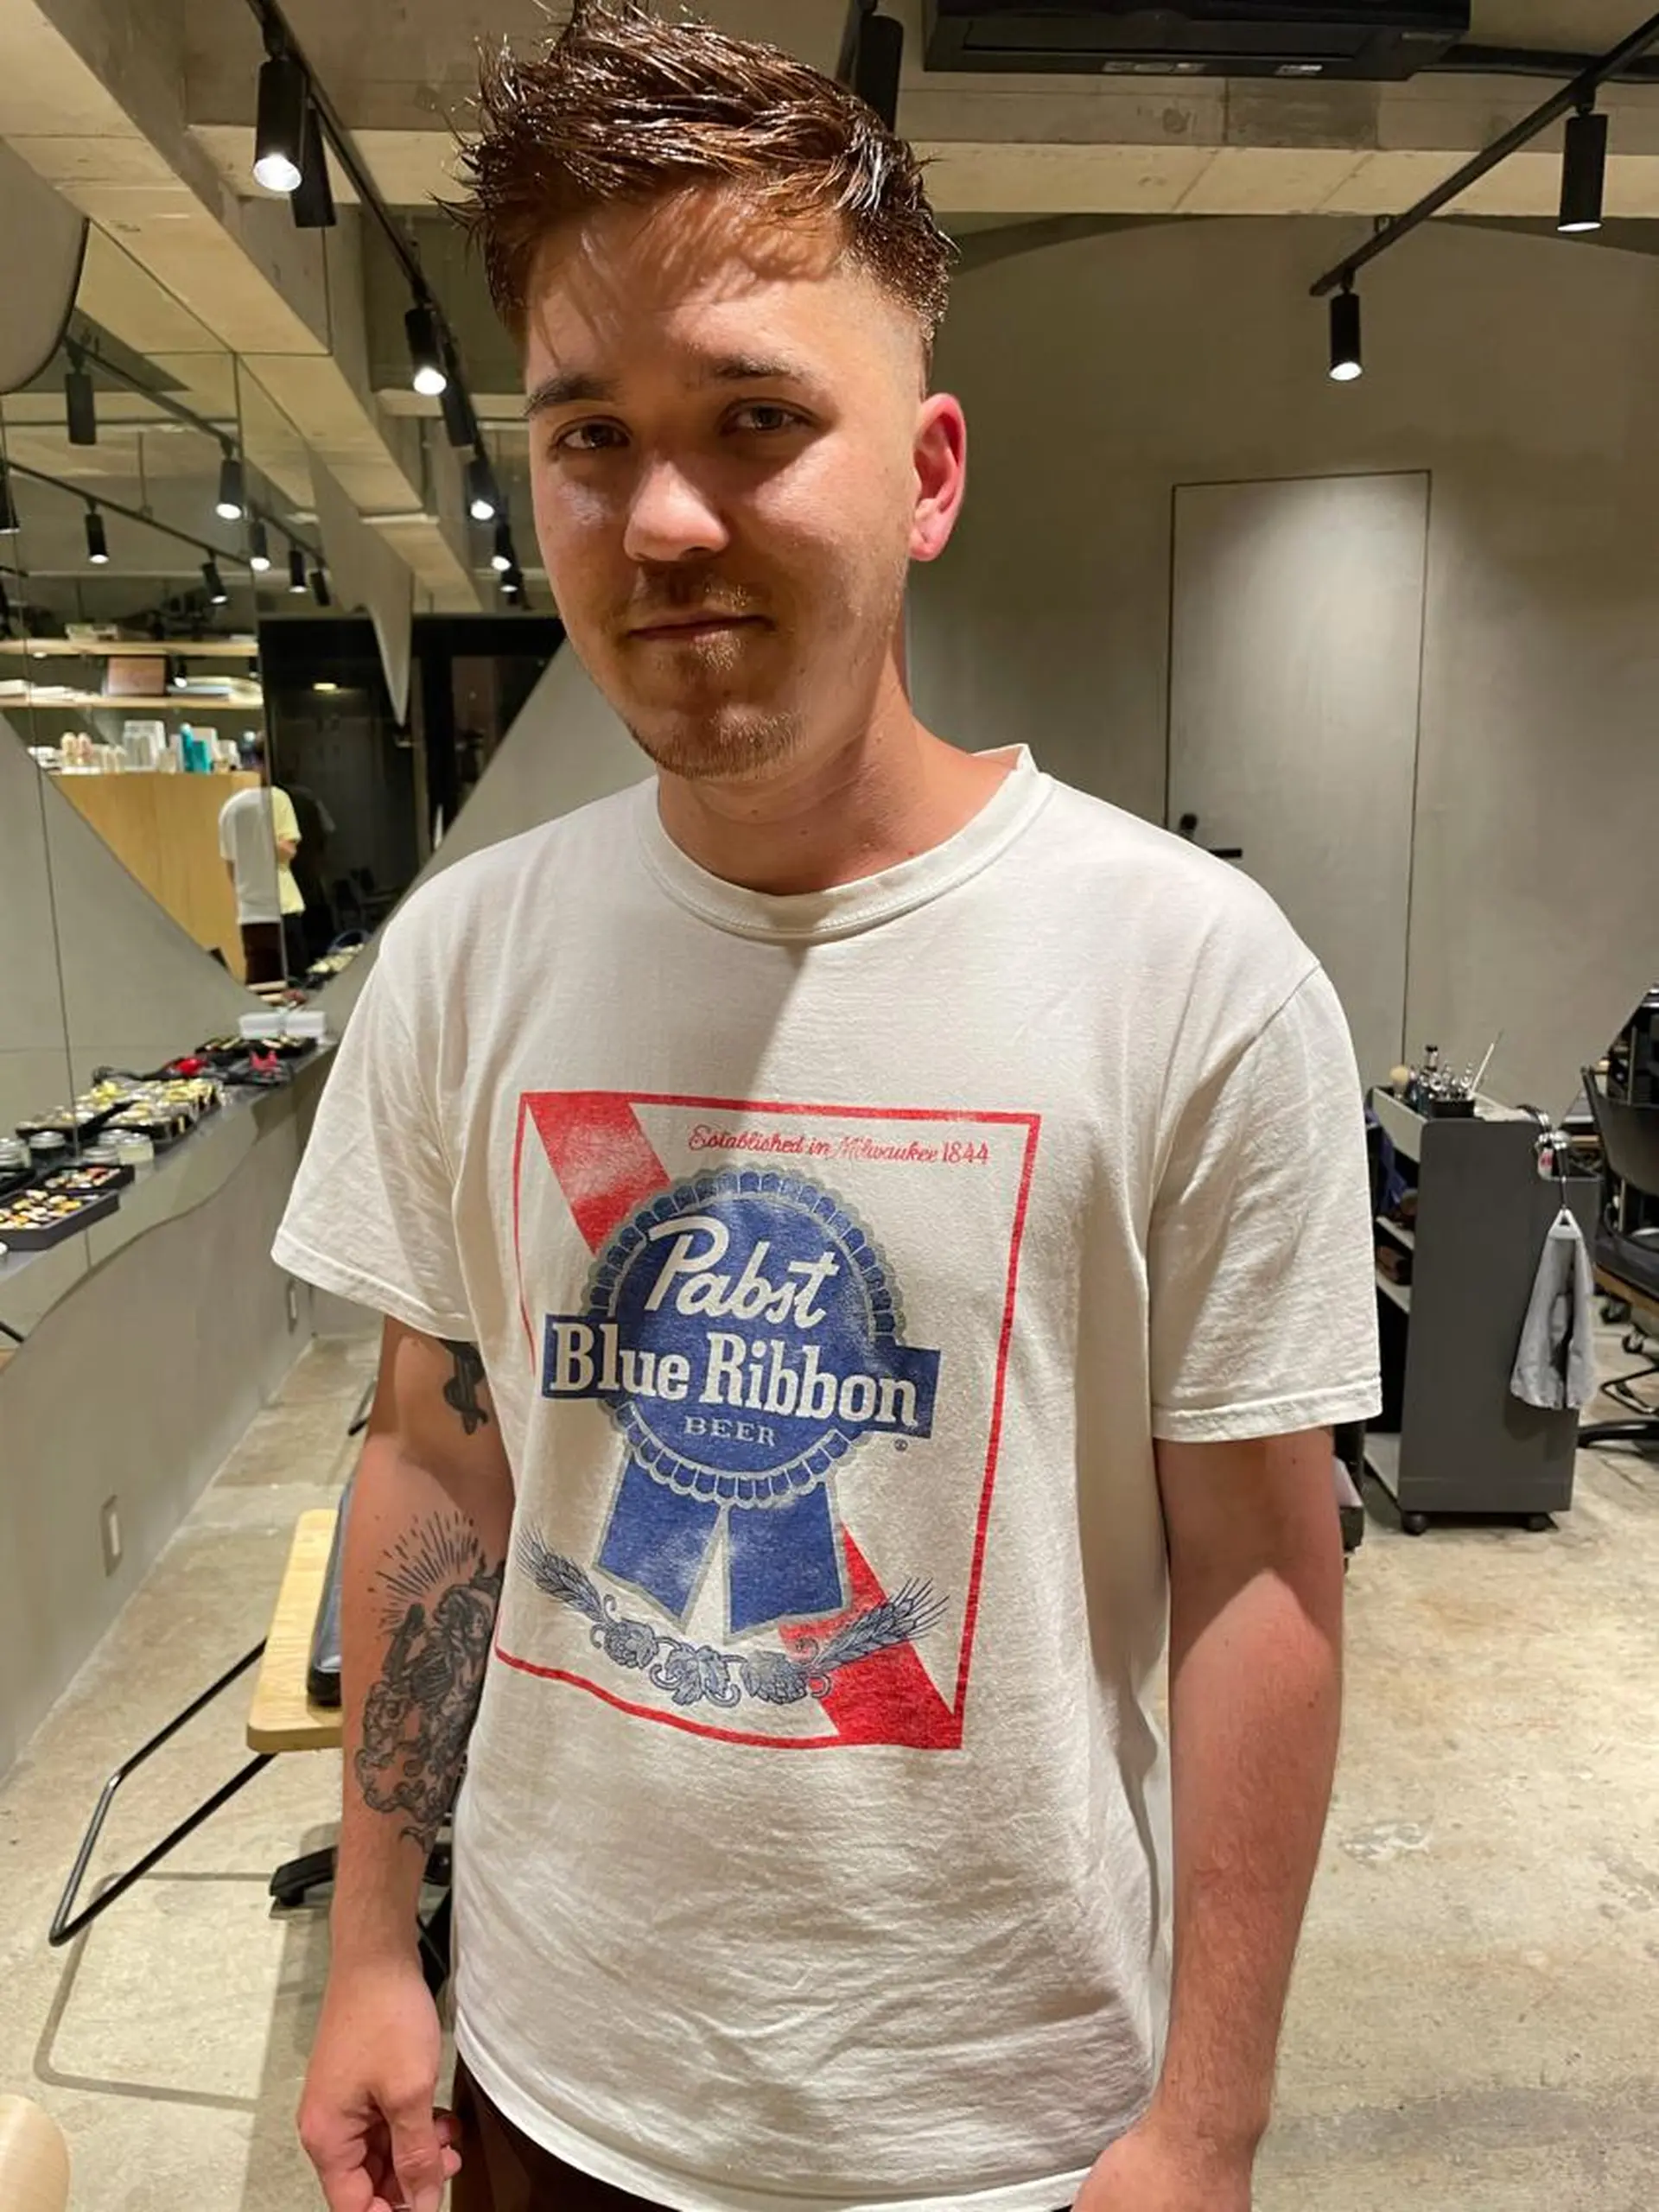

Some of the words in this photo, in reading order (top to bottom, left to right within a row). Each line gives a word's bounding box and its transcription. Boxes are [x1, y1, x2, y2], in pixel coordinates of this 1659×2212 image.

[689, 1124, 804, 1154] Established
[808, 1137, 830, 1157] in
[942, 1140, 991, 1166] 1844
[645, 1215, 839, 1329] Pabst
[549, 1322, 690, 1401] Blue
[699, 1332, 919, 1427] Ribbon
[683, 1416, 776, 1448] BEER
